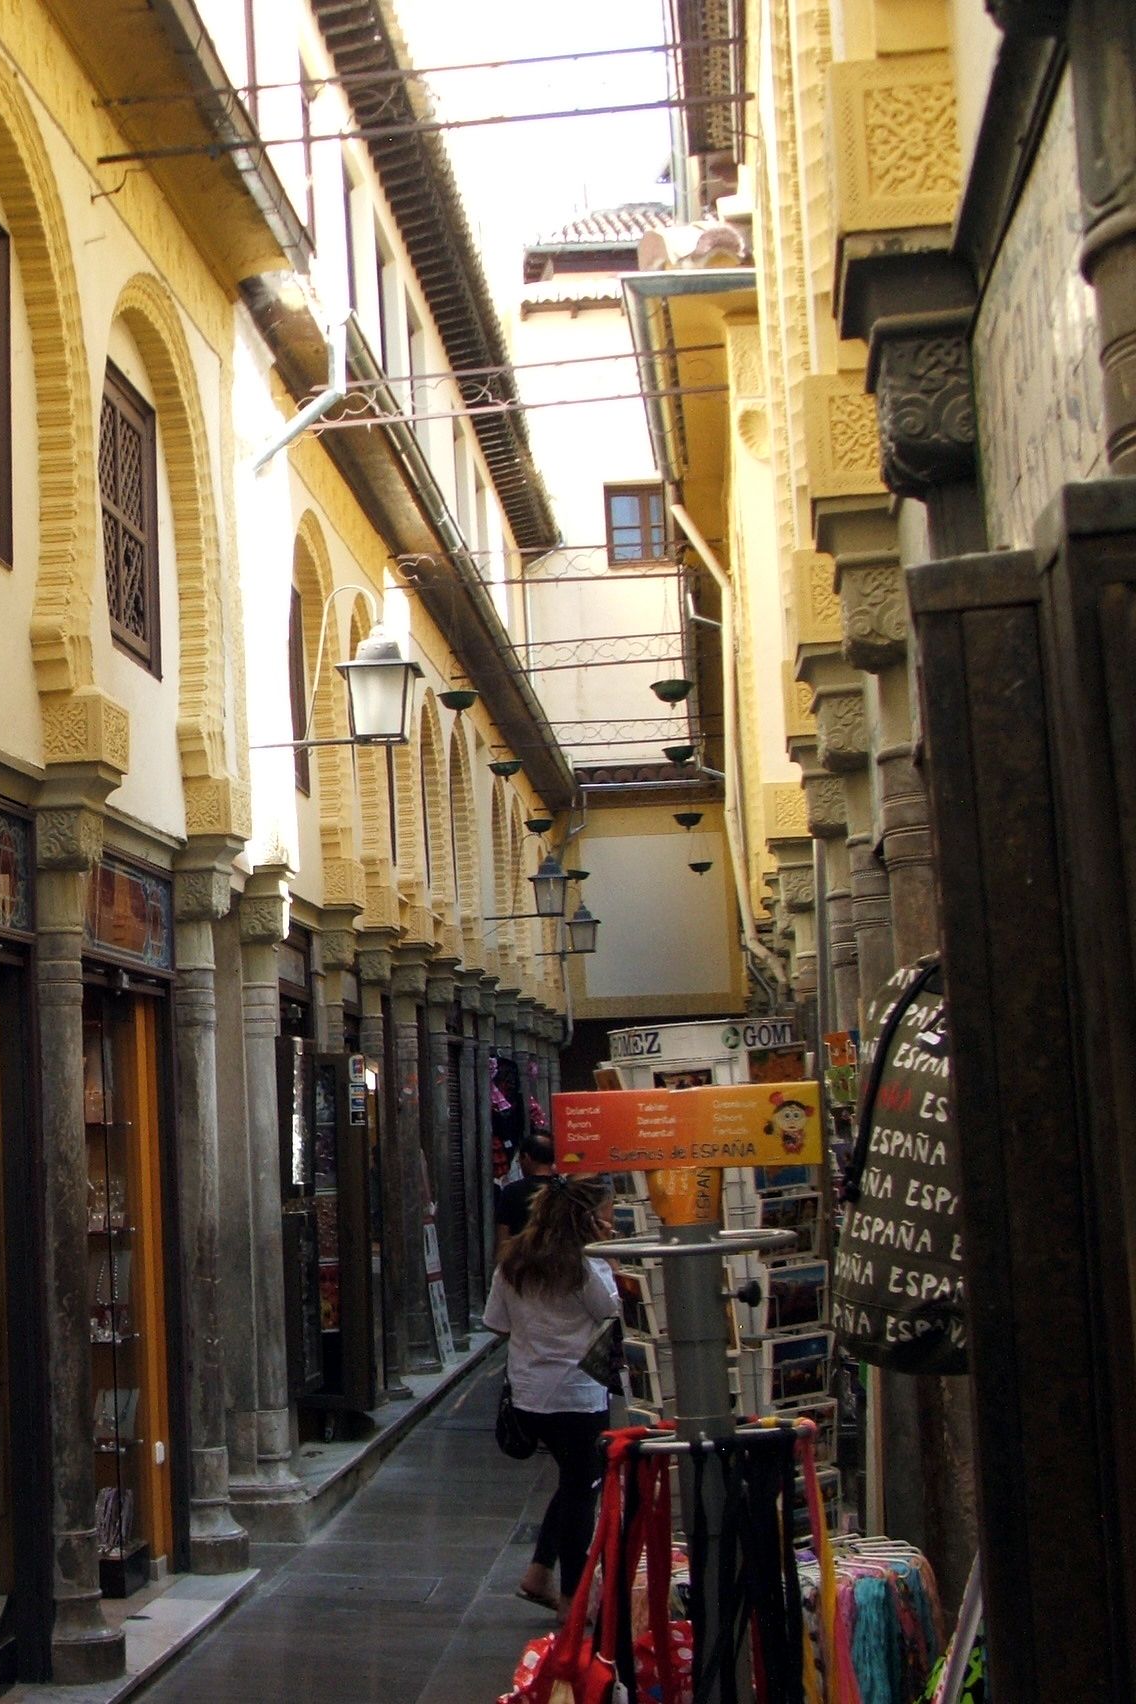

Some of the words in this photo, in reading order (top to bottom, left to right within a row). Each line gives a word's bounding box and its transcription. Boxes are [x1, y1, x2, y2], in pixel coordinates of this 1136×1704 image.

[671, 1144, 686, 1159] de
[692, 1138, 756, 1159] ESPAÑA
[869, 1126, 946, 1166] ESPAÑA
[851, 1211, 932, 1254] ESPAÑA
